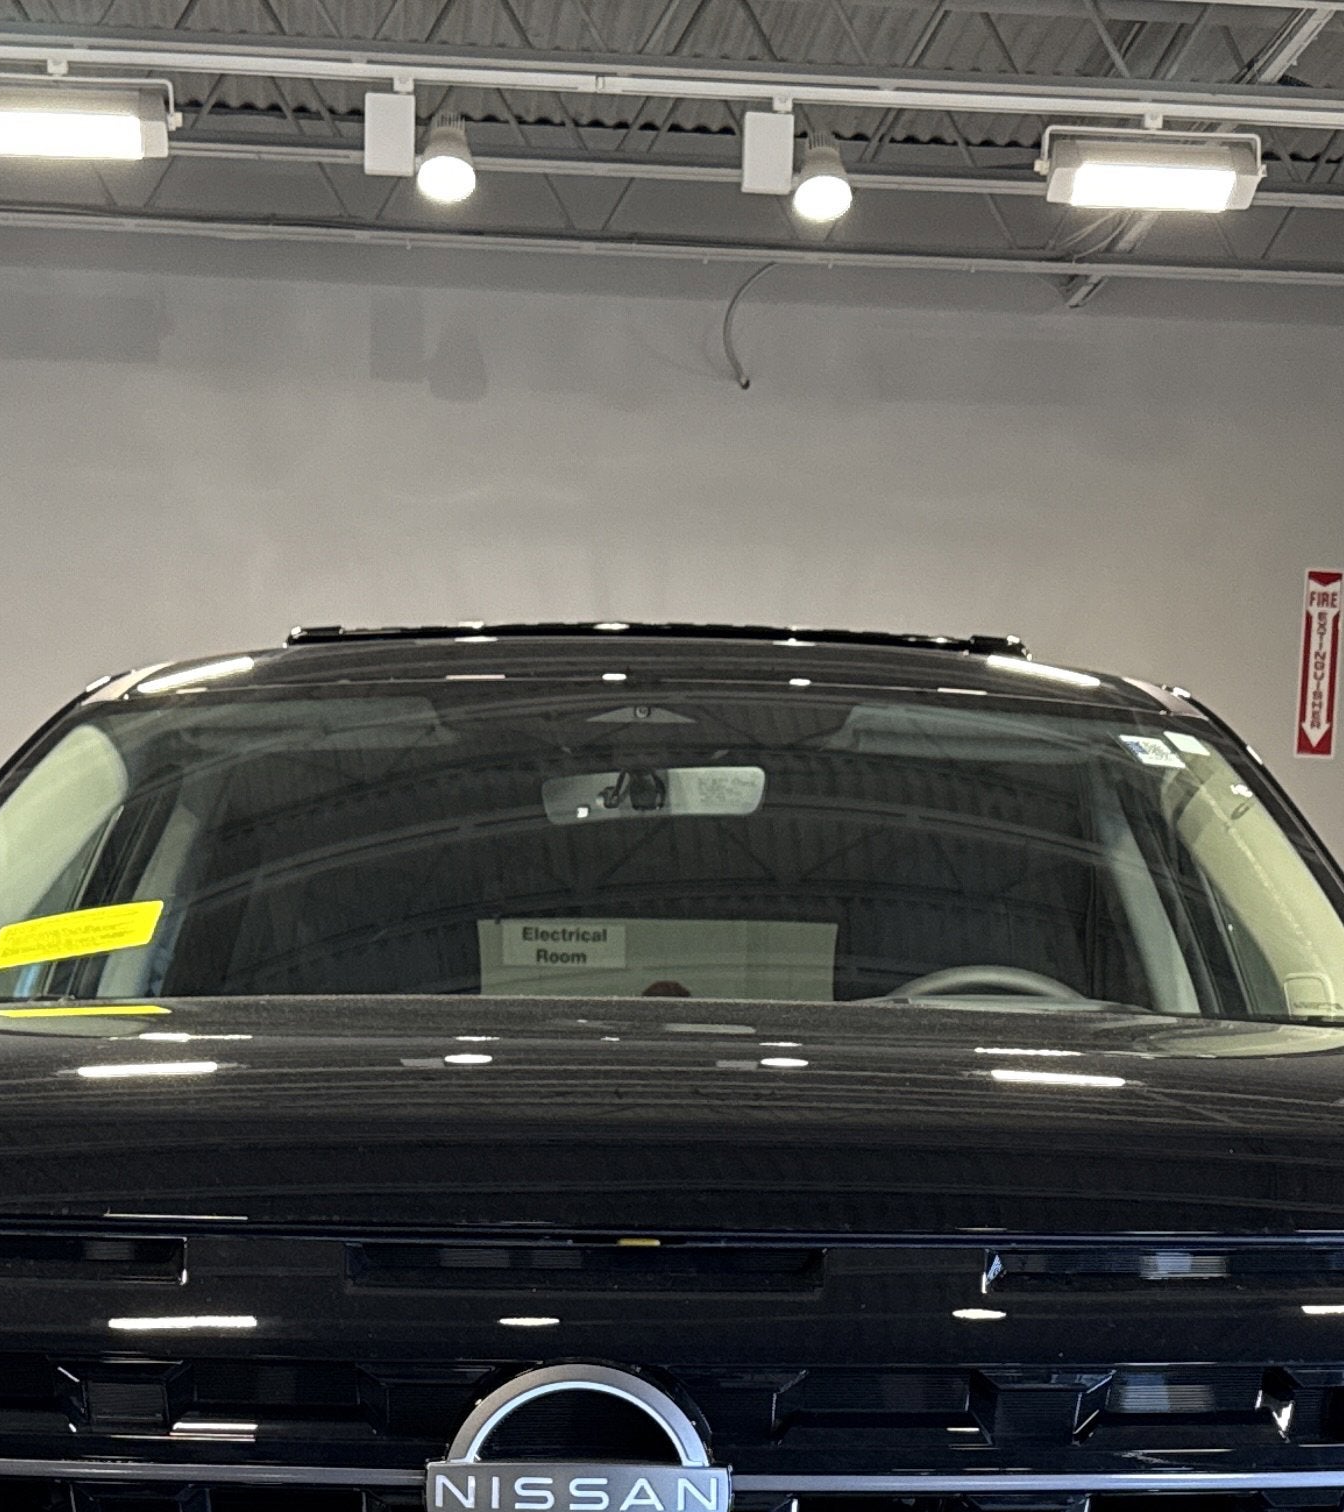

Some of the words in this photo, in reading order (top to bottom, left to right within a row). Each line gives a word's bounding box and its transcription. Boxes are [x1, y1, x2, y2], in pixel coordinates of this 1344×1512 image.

[1310, 592, 1338, 608] FIRE
[1311, 612, 1327, 729] EXTINGUISHER
[523, 927, 607, 942] Electrical
[536, 949, 587, 963] Room
[434, 1474, 719, 1511] NISSAN
